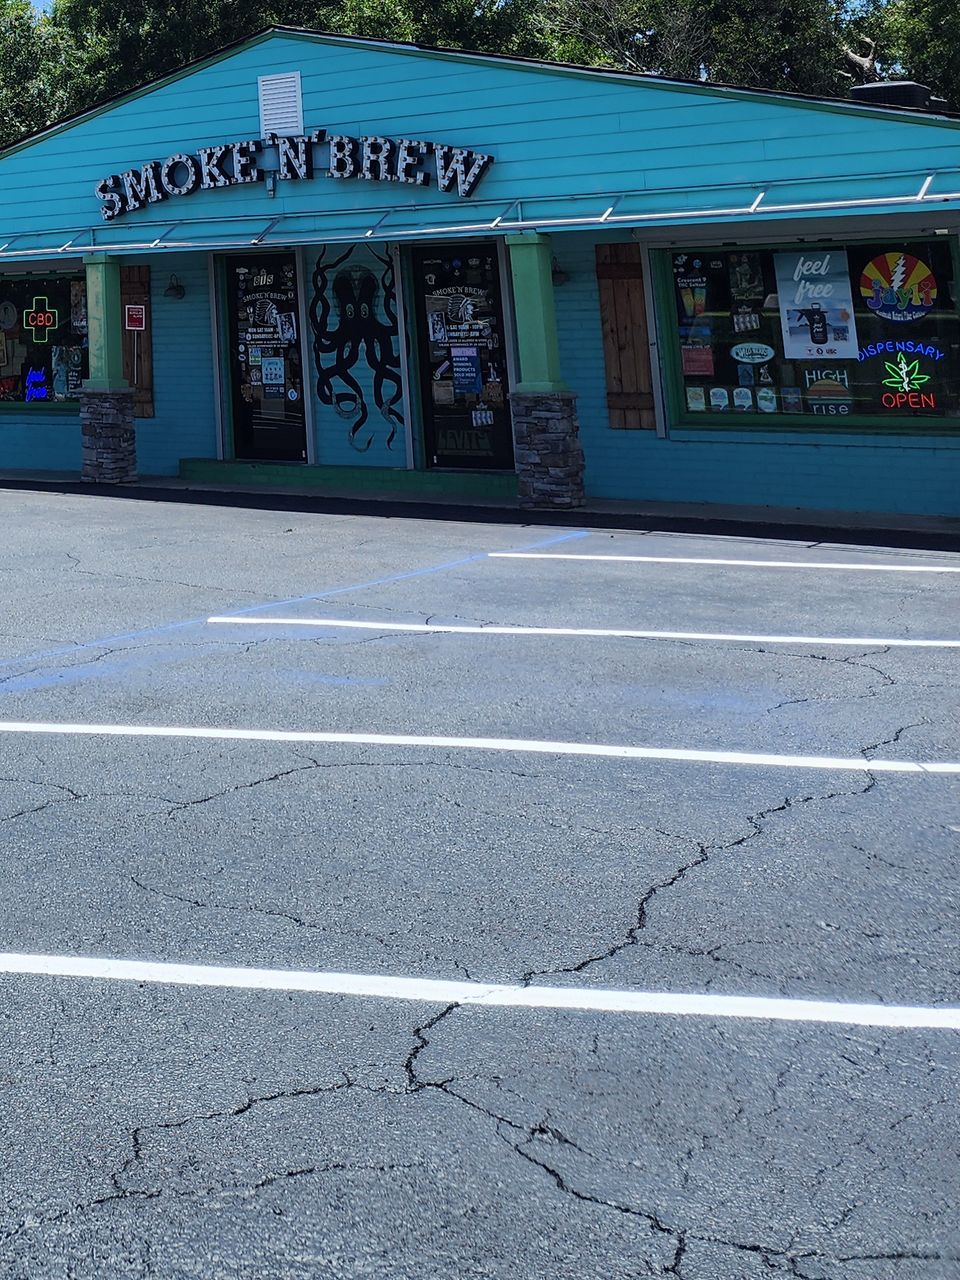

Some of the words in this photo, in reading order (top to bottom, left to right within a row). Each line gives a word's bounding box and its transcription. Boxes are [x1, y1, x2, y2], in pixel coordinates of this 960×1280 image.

[94, 139, 264, 221] SMOKE
[327, 135, 495, 199] BREW
[793, 254, 831, 282] feel
[793, 279, 833, 305] free
[28, 313, 54, 326] CBD
[857, 341, 945, 363] DISPENSARY
[805, 369, 849, 389] HIGH
[813, 403, 849, 415] rise
[881, 392, 936, 409] OPEN
